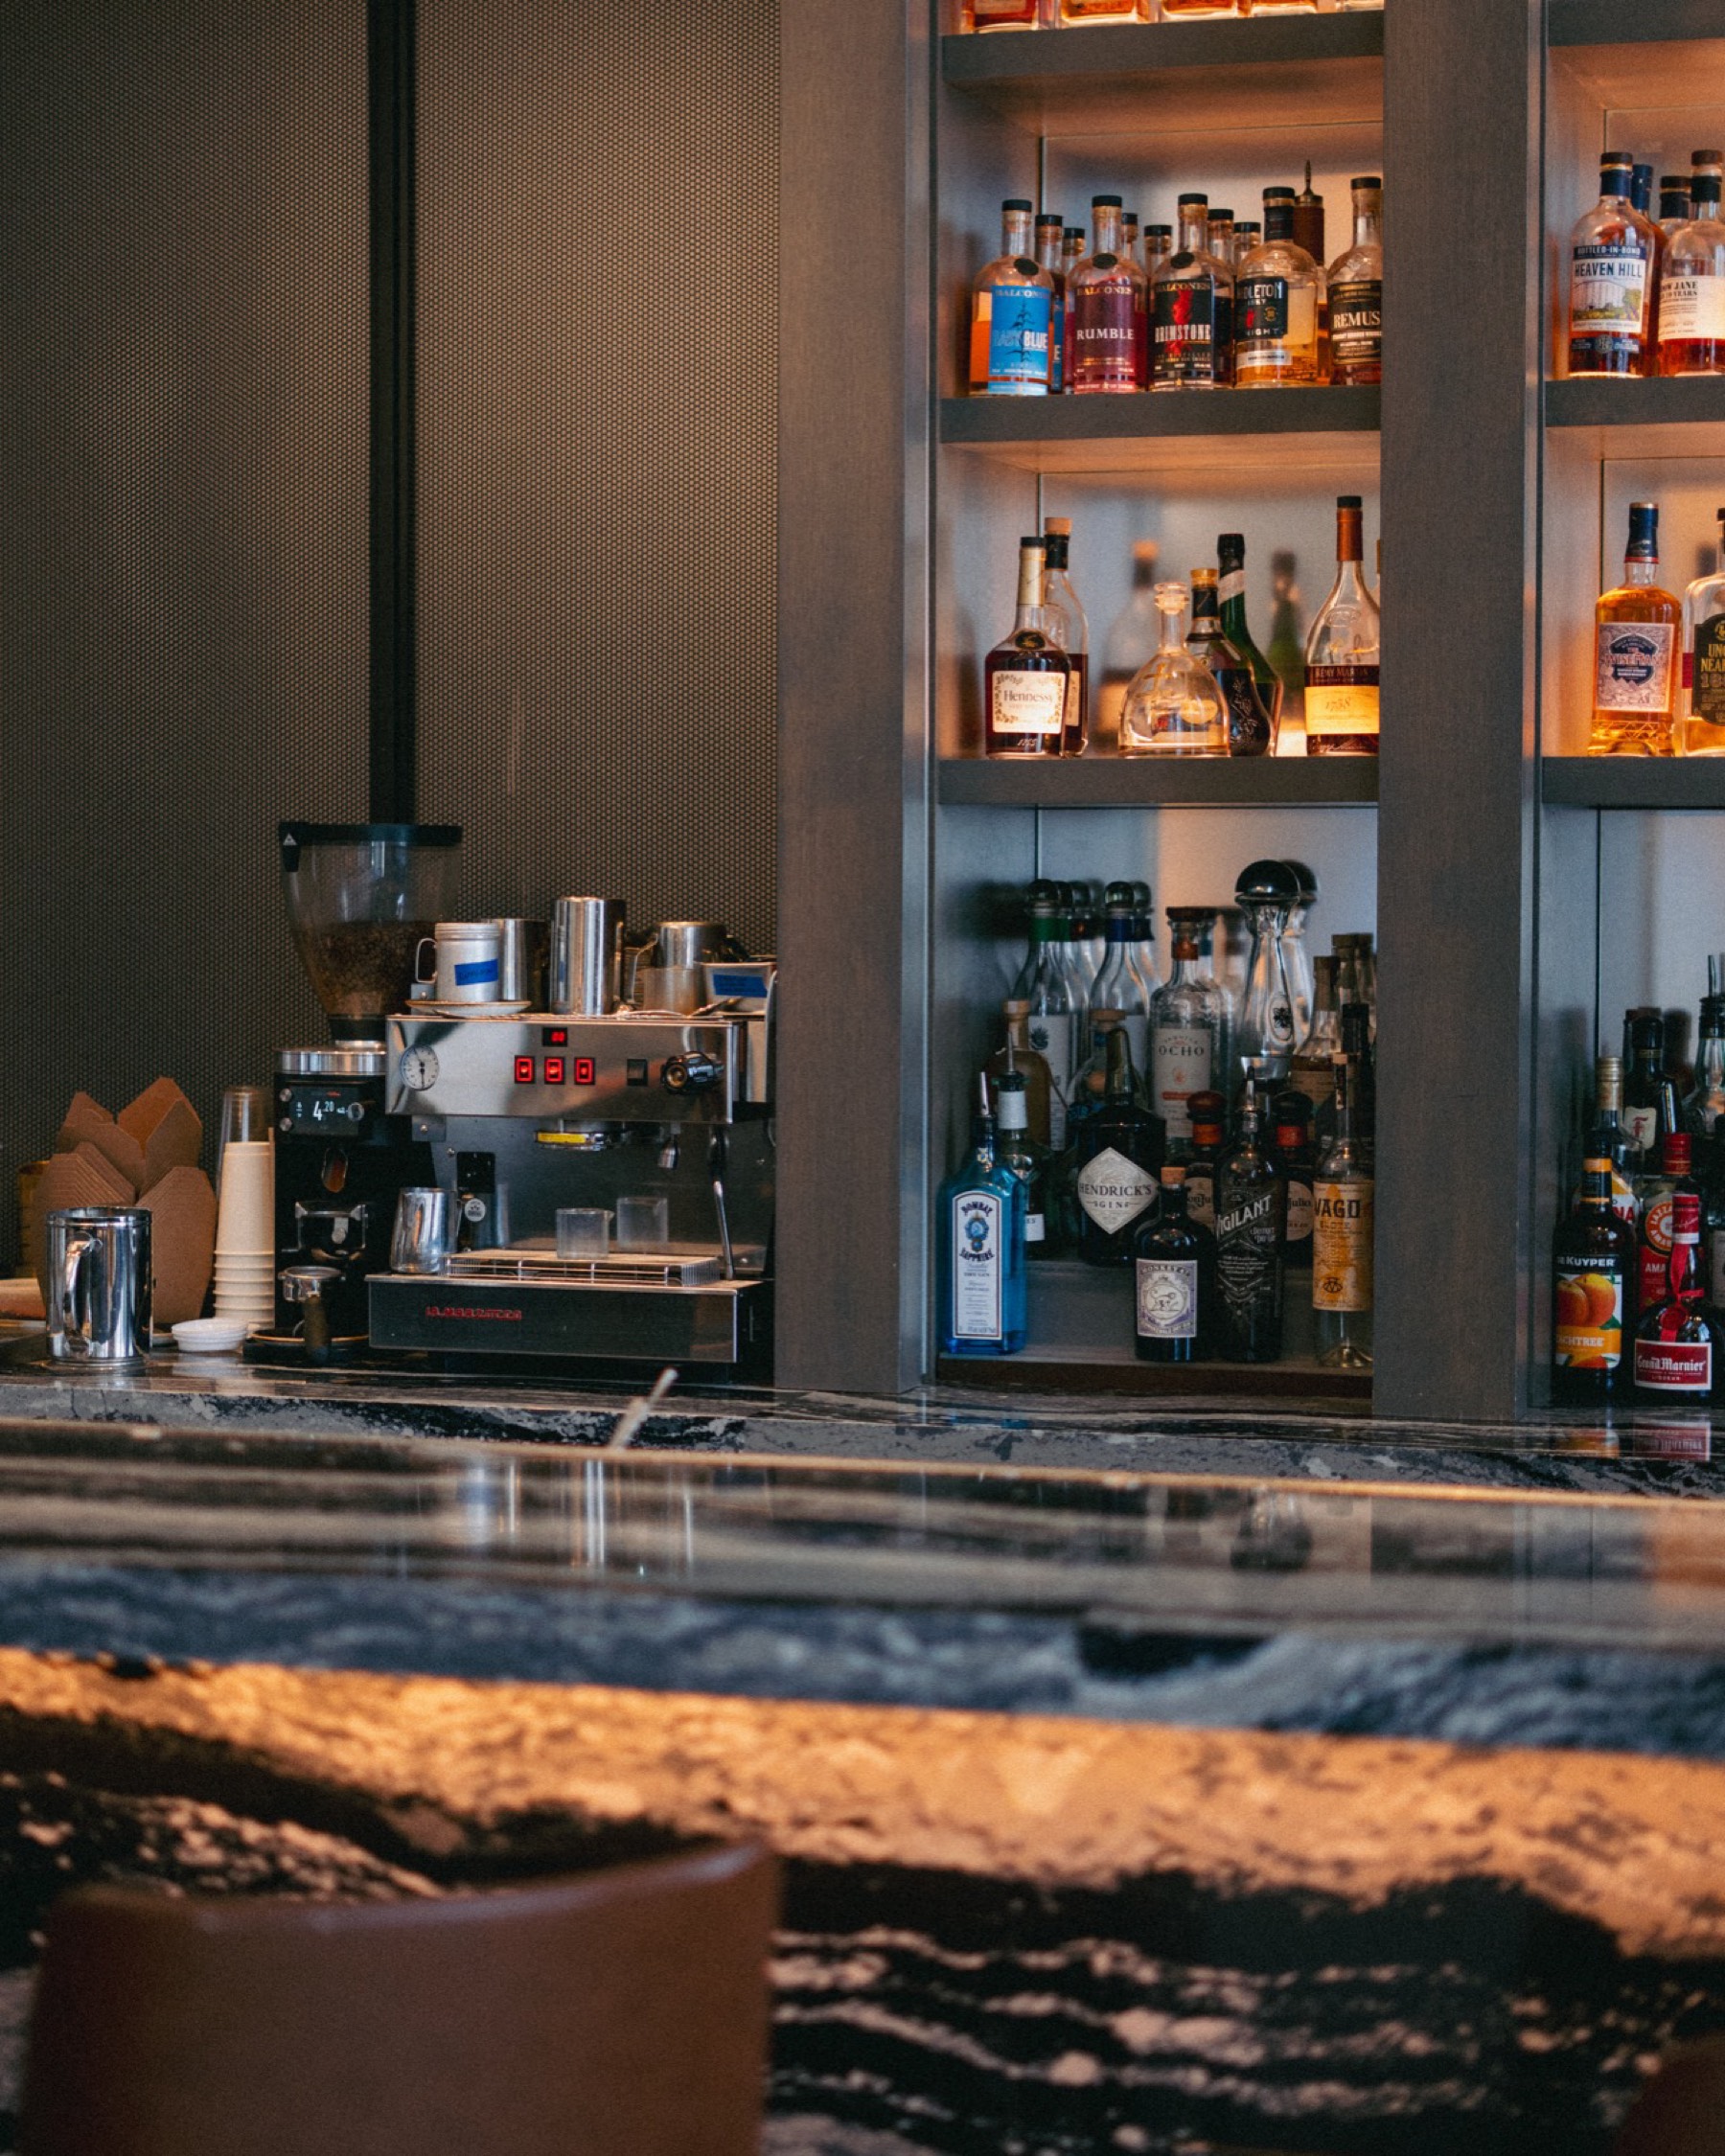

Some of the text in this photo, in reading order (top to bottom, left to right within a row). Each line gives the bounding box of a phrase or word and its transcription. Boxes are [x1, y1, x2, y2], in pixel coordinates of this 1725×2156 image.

[1575, 263, 1643, 278] HEAVEN HILL
[1674, 281, 1698, 289] JANE
[1333, 310, 1381, 330] REMUS
[1024, 331, 1048, 349] BLUE
[1076, 328, 1135, 340] RUMBLE
[1154, 324, 1211, 343] BRIMSTONE
[1003, 690, 1052, 702] Hennessy
[1158, 1045, 1205, 1056] OCHO
[1078, 1182, 1153, 1197] HENDRICK'S
[961, 1201, 994, 1218] BOMBAY
[1098, 1200, 1123, 1208] GIN
[1314, 1198, 1361, 1219] VAGO
[1215, 1194, 1273, 1242] VIGILANT
[959, 1247, 996, 1262] SAPPHIRE
[1566, 1256, 1616, 1267] KUYPER
[1637, 1355, 1707, 1372] Grand Marnier
